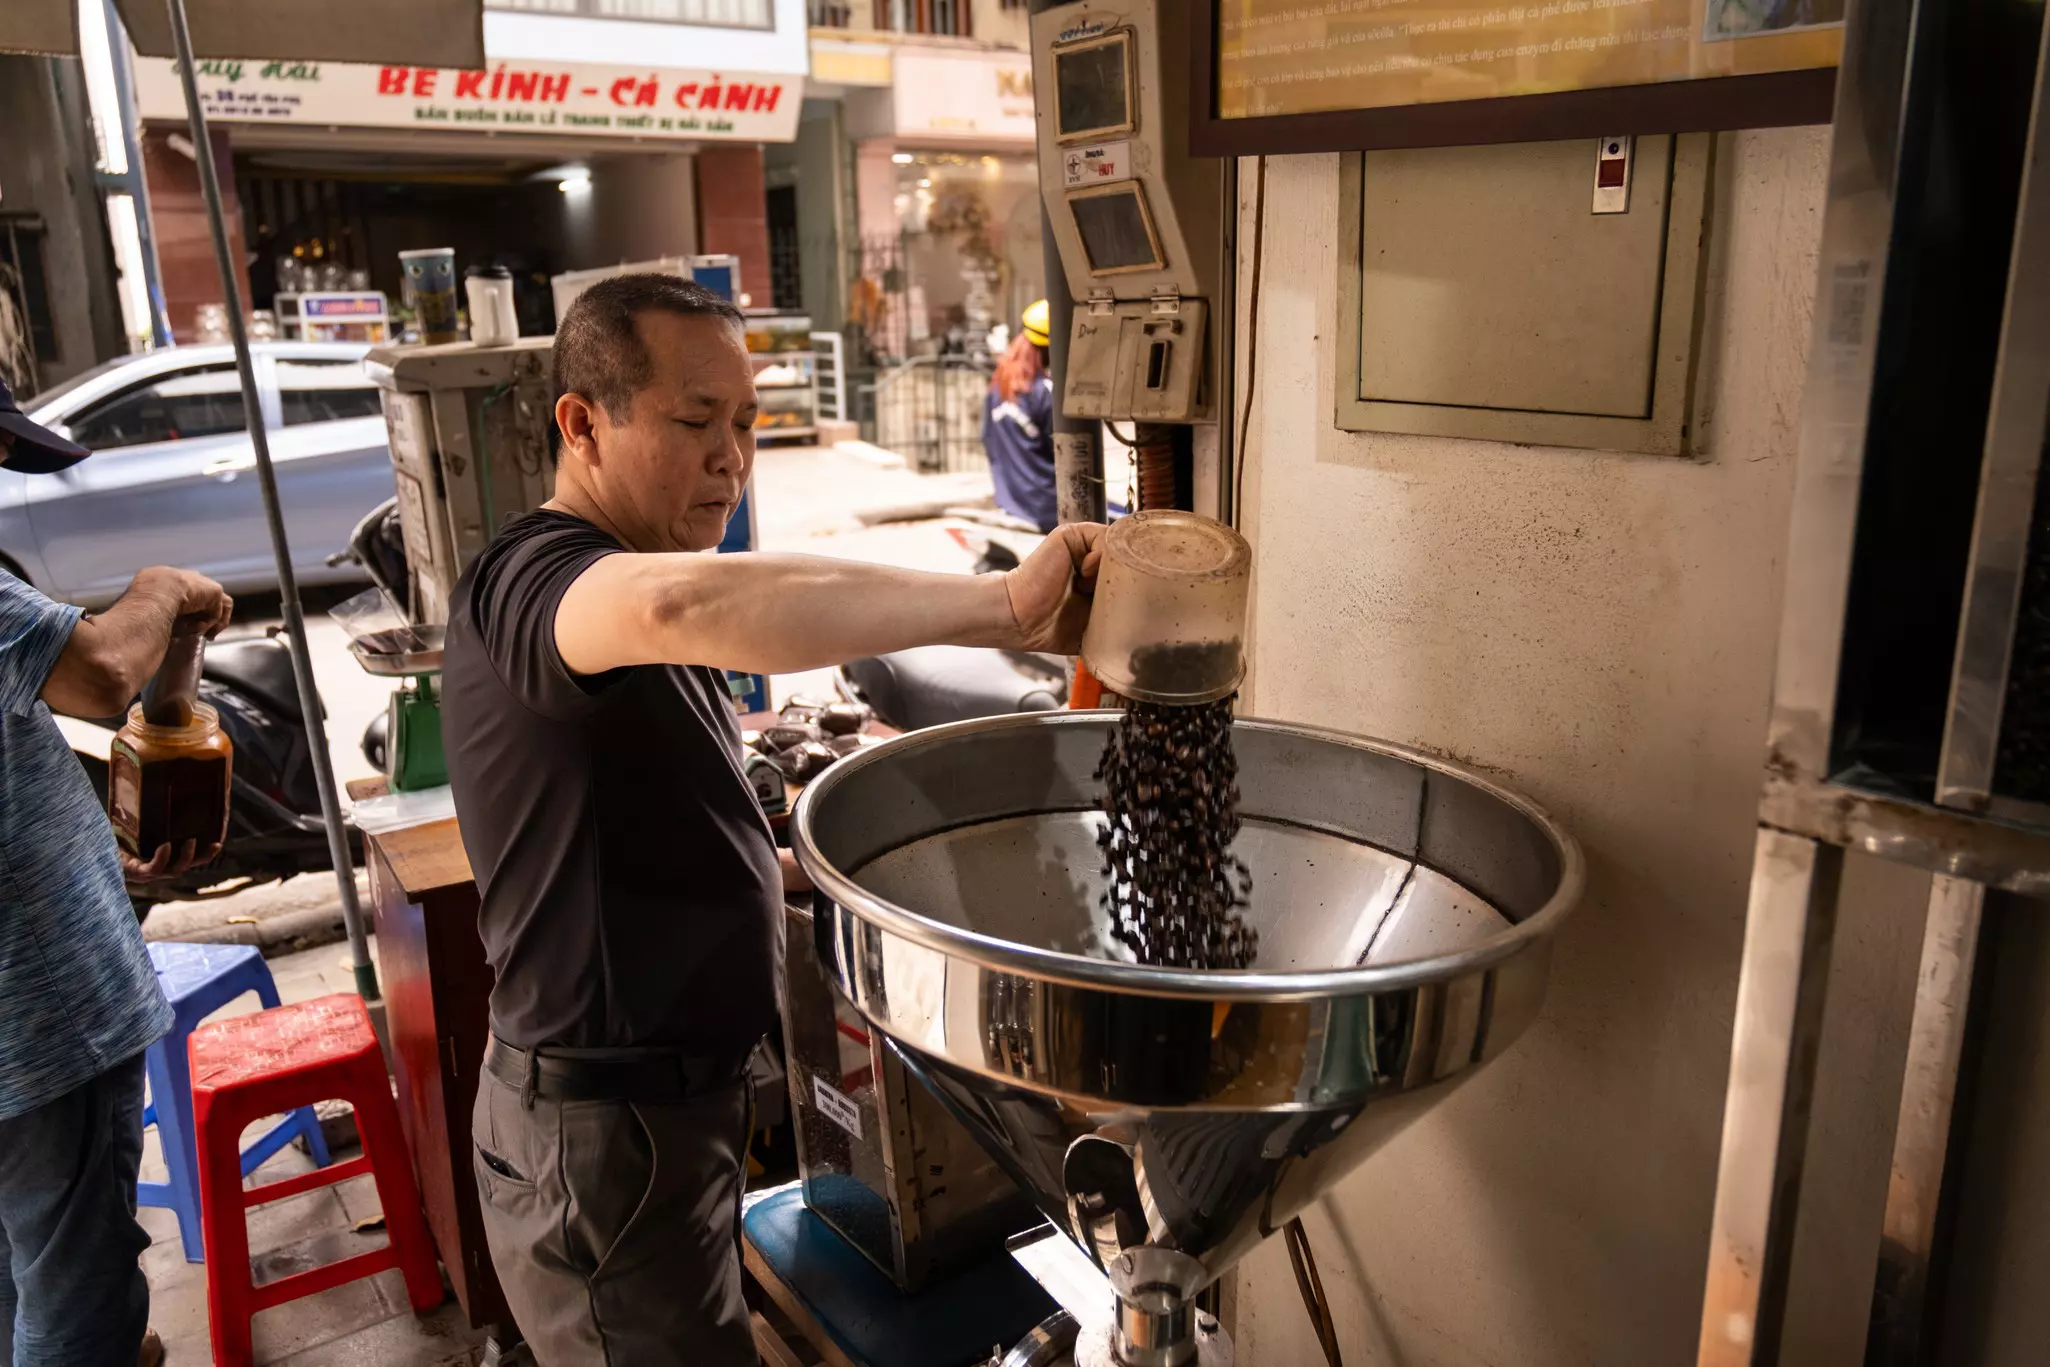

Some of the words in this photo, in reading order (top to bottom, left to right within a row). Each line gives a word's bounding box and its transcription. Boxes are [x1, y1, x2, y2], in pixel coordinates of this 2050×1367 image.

[1516, 42, 1550, 59] enzym
[454, 62, 572, 104] KÍNH
[608, 73, 660, 109] CÁ
[673, 74, 783, 114] CẢNH
